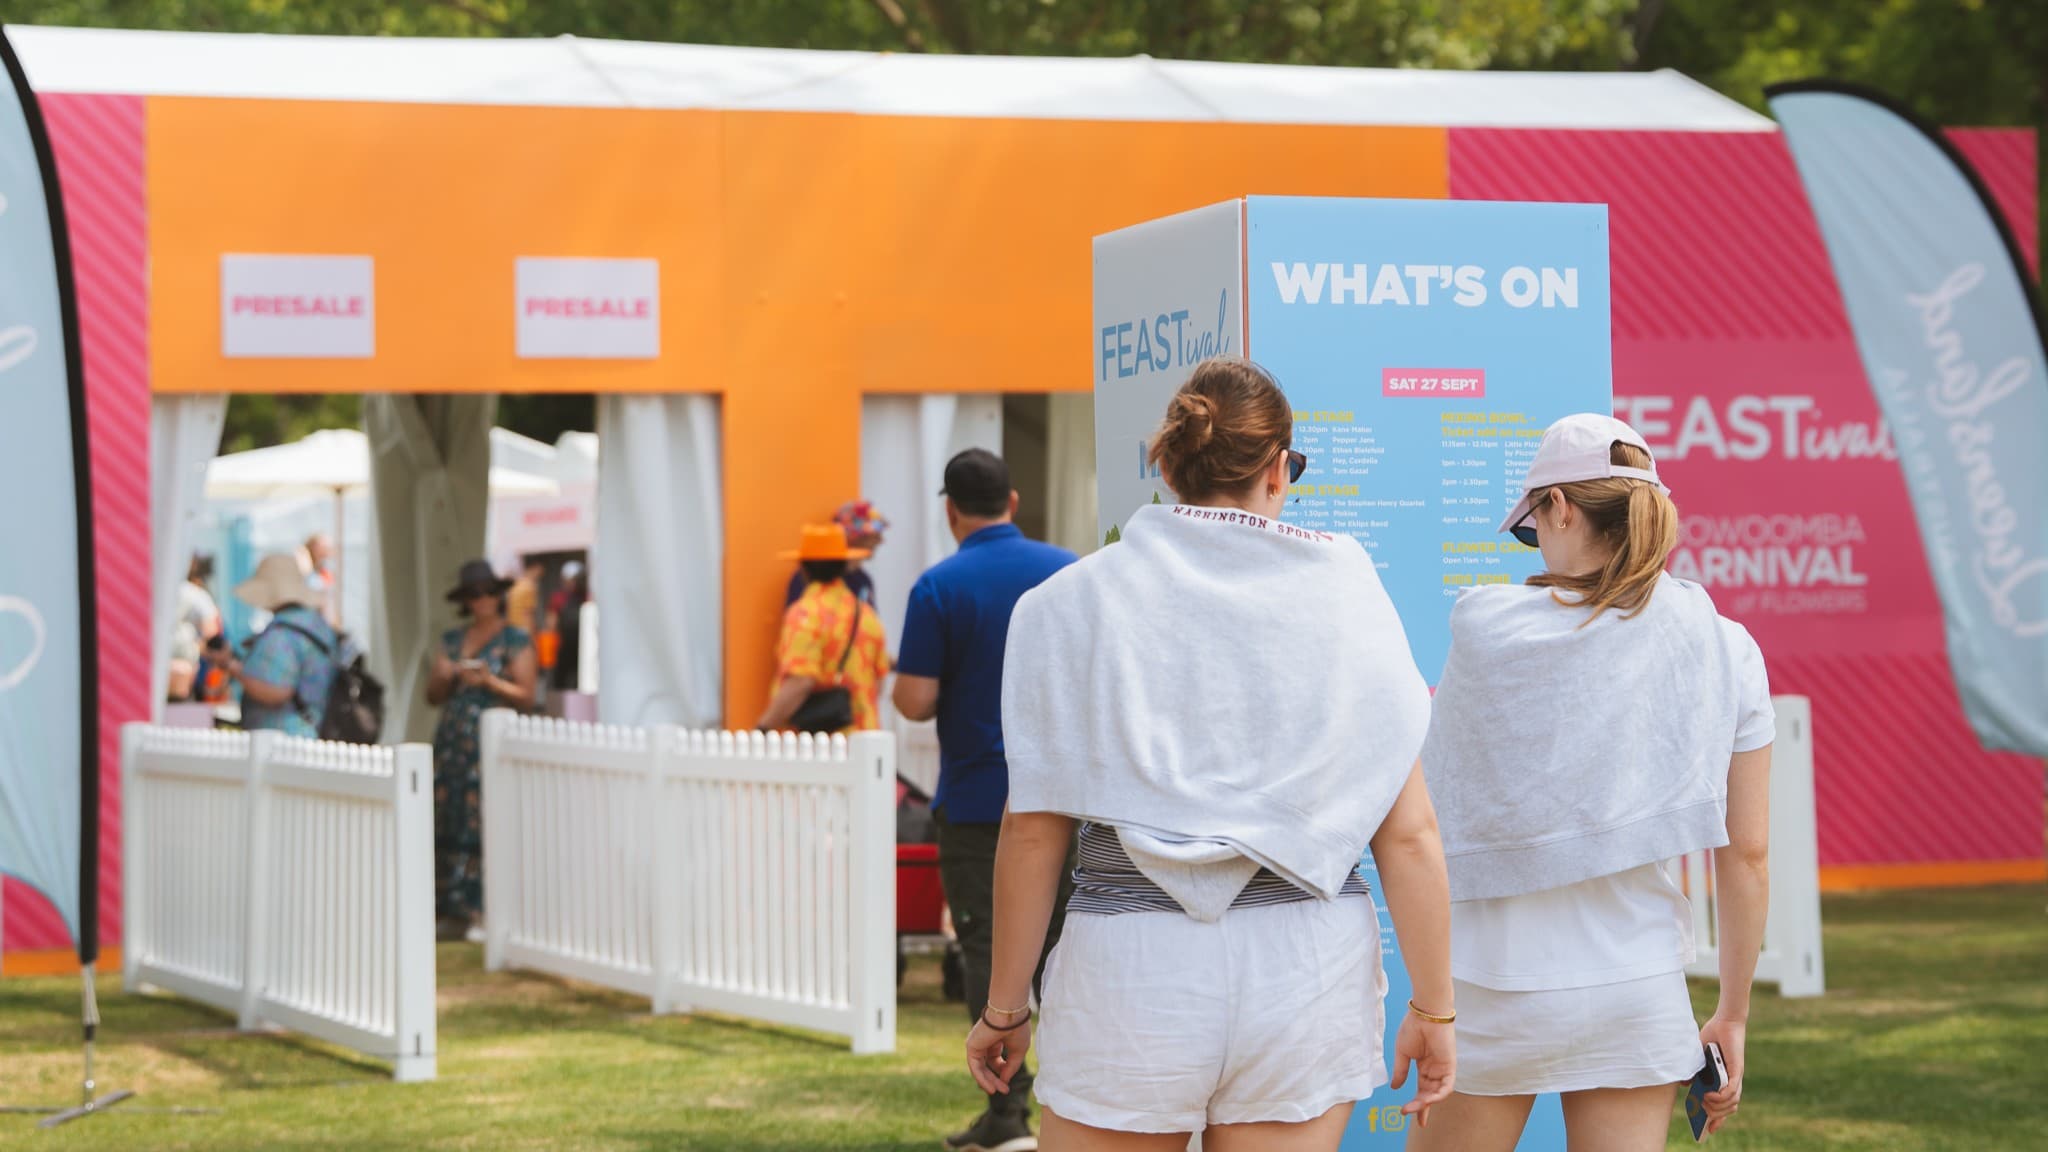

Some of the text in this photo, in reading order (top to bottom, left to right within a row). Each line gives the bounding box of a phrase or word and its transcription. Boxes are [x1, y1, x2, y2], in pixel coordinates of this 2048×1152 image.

[1271, 262, 1579, 308] WHAT'S ON
[233, 295, 364, 317] PRESALE
[525, 298, 650, 318] PRESALE
[1102, 288, 1230, 381] FEASTival
[1389, 378, 1478, 391] SAT 27 SEPT
[1313, 411, 1354, 422] STAGE
[1489, 412, 1528, 424] BOWL
[1613, 396, 1898, 461] EASTival
[1319, 485, 1359, 496] STAGE
[1173, 506, 1268, 529] WASHINGTON
[1677, 514, 1866, 545] OWOOMBA
[1443, 542, 1496, 554] FLOWER
[1443, 557, 1460, 565] Open
[1669, 548, 1868, 585] ARNIVAL
